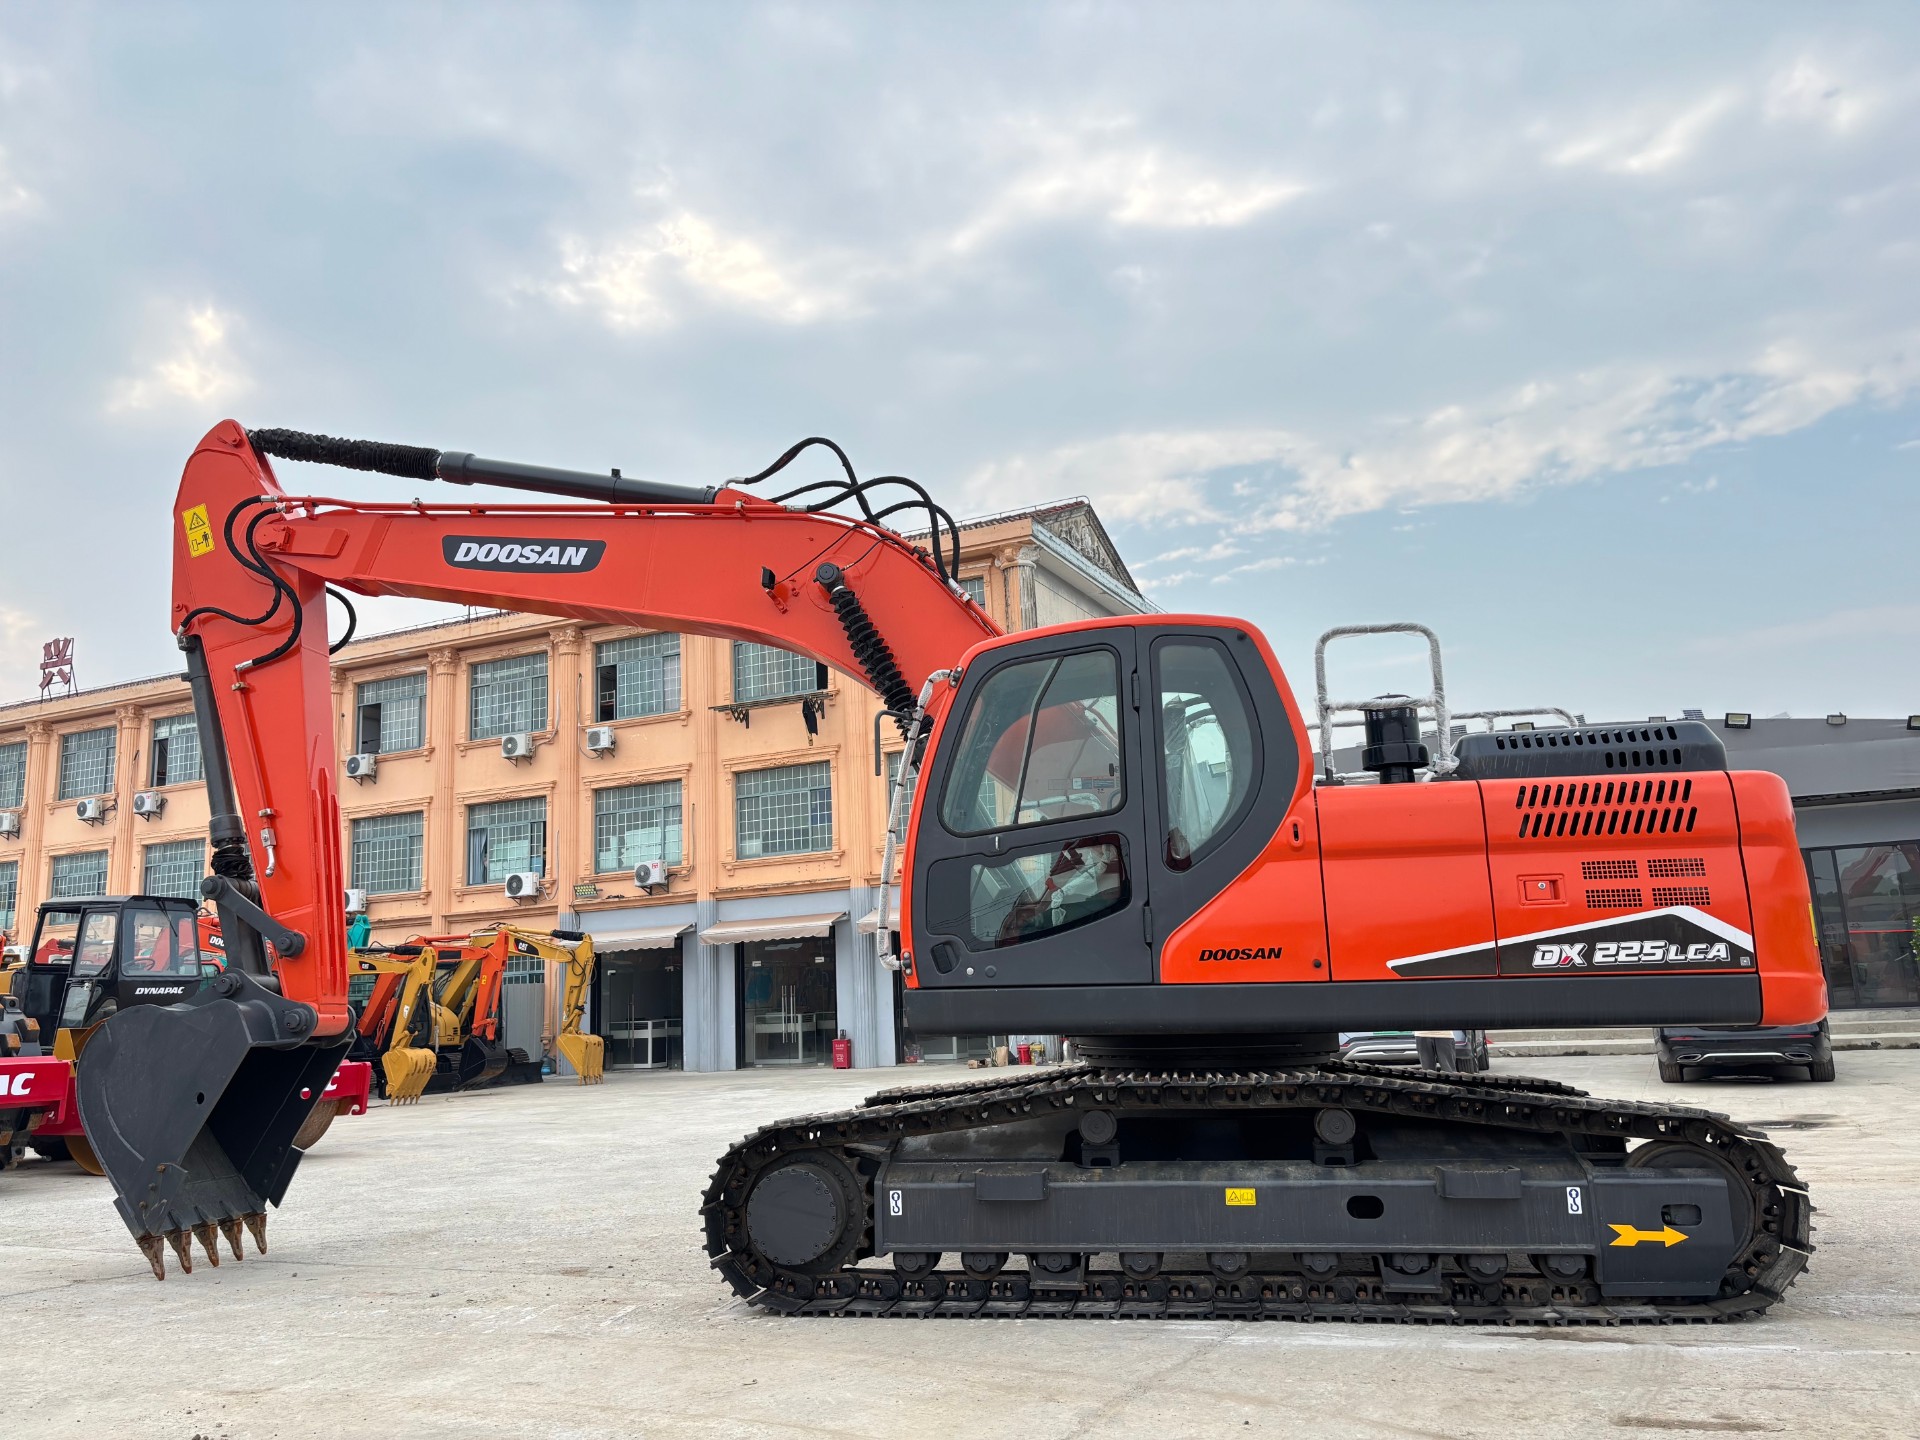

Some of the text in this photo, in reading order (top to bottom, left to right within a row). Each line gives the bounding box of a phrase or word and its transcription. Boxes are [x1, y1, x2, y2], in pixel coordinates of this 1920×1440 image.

[453, 542, 589, 566] DOOSAN
[38, 636, 73, 690] 兴
[1198, 947, 1283, 962] DOOSAN
[1532, 942, 1588, 968] DX
[134, 986, 186, 995] DYNAPAC
